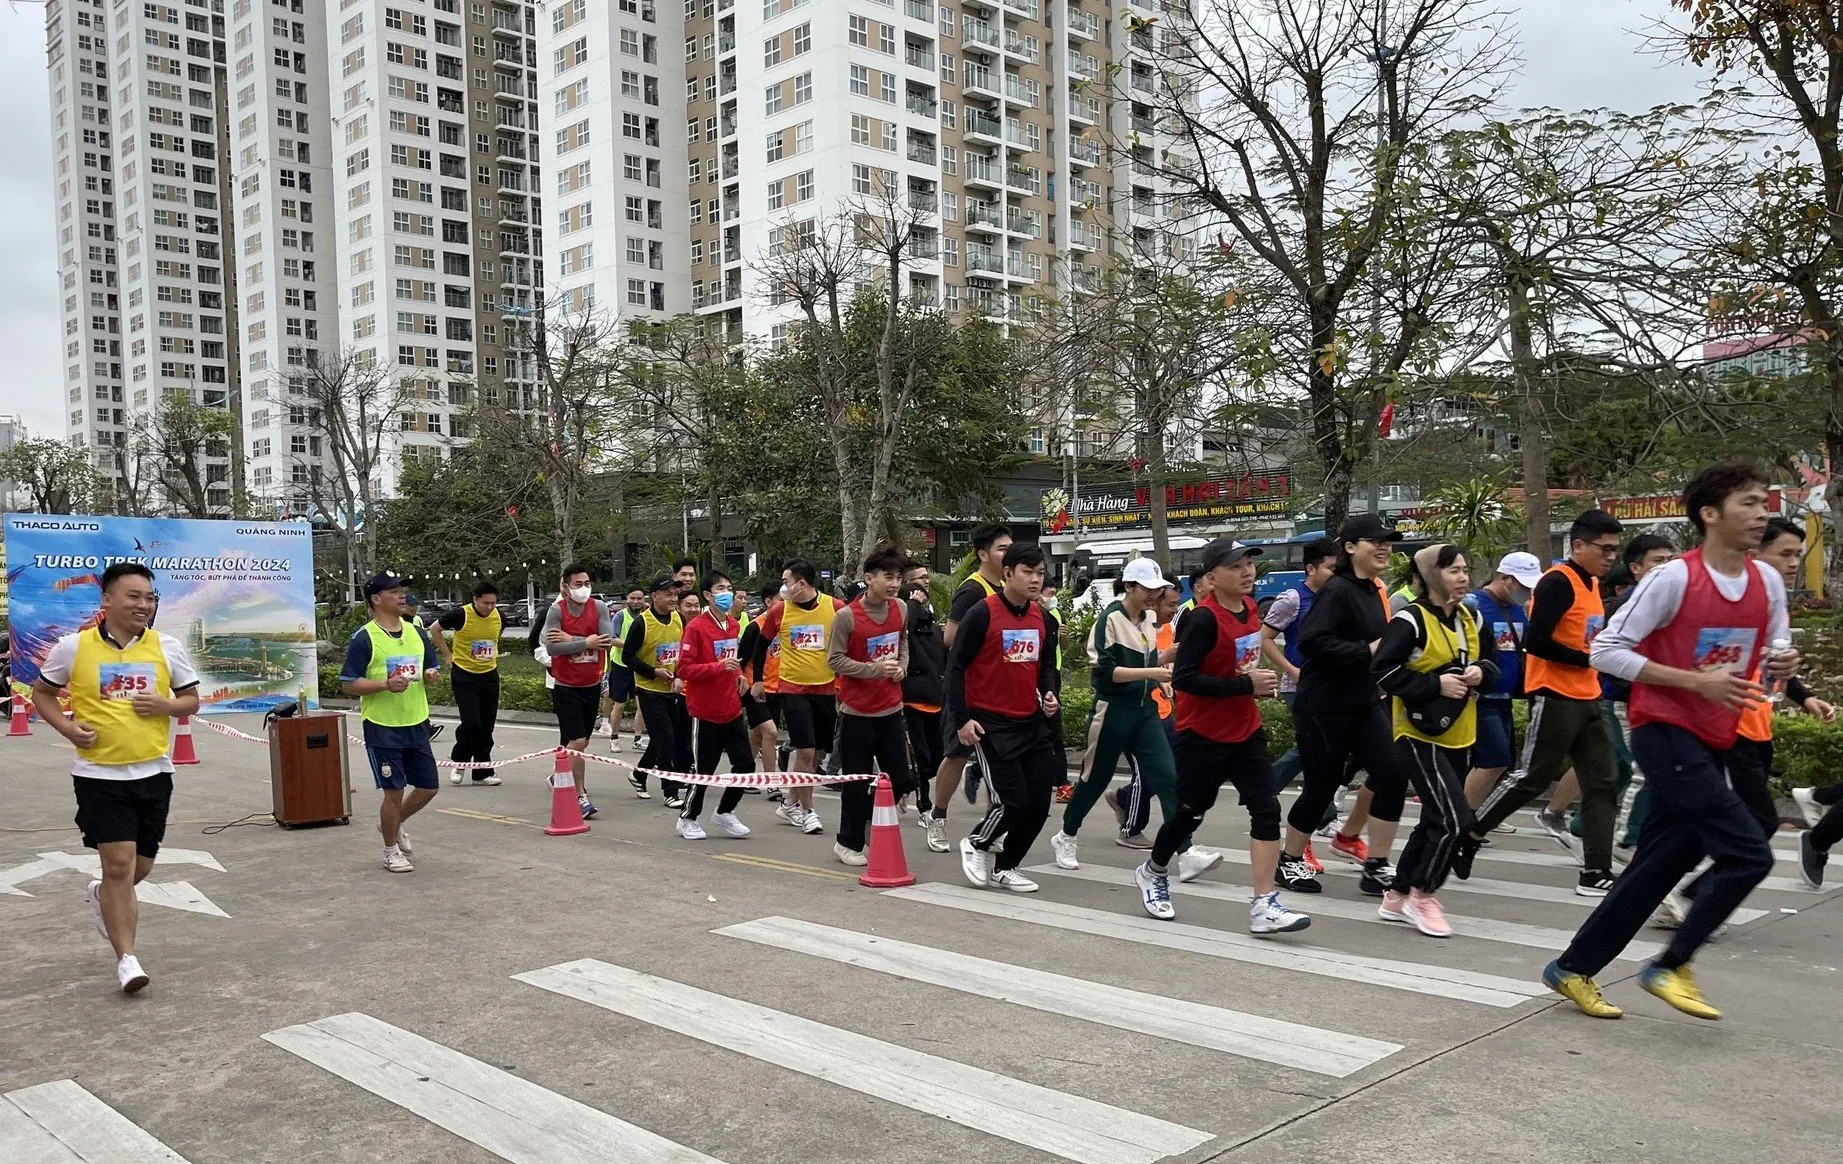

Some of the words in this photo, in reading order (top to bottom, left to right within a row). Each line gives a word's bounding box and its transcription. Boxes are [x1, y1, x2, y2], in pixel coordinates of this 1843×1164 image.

[1097, 494, 1129, 511] Hàng
[12, 521, 60, 530] THACO
[62, 521, 99, 531] AUTO
[236, 527, 276, 536] QUẢNG
[34, 554, 99, 569] TURBO
[151, 556, 248, 571] MARATHON
[251, 558, 291, 571] 2024
